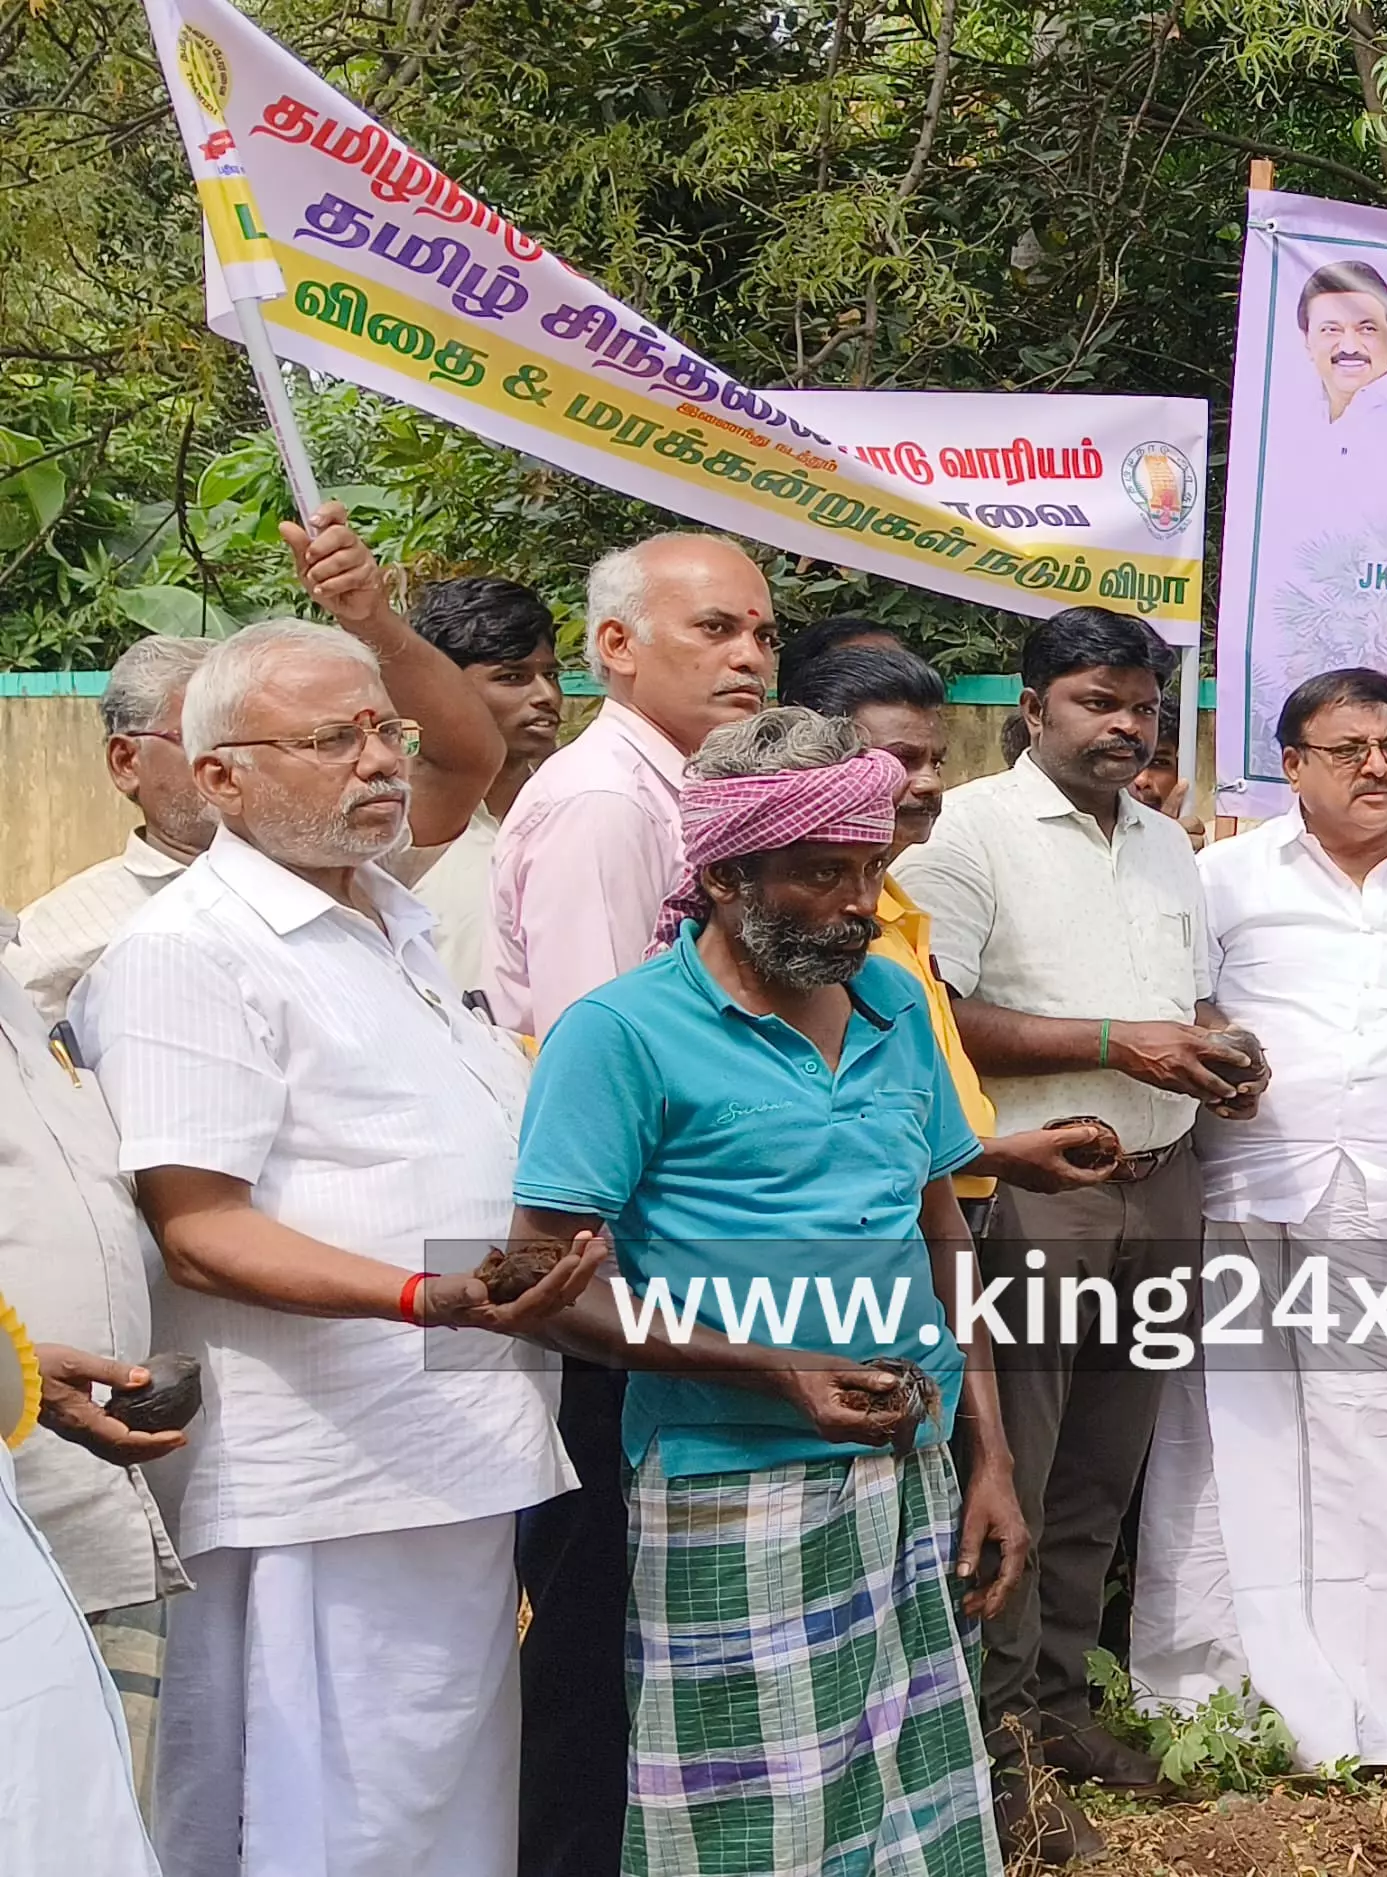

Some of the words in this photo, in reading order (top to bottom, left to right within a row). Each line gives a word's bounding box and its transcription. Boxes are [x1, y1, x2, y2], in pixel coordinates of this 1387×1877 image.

[294, 193, 528, 318] தமிழ்
[294, 279, 488, 387] விதை
[503, 365, 553, 409] &
[564, 393, 976, 558] மரக்கன்றுகள்
[963, 547, 1091, 593] நடும்
[1099, 561, 1189, 610] விழா
[939, 437, 1103, 486] வாரியம்
